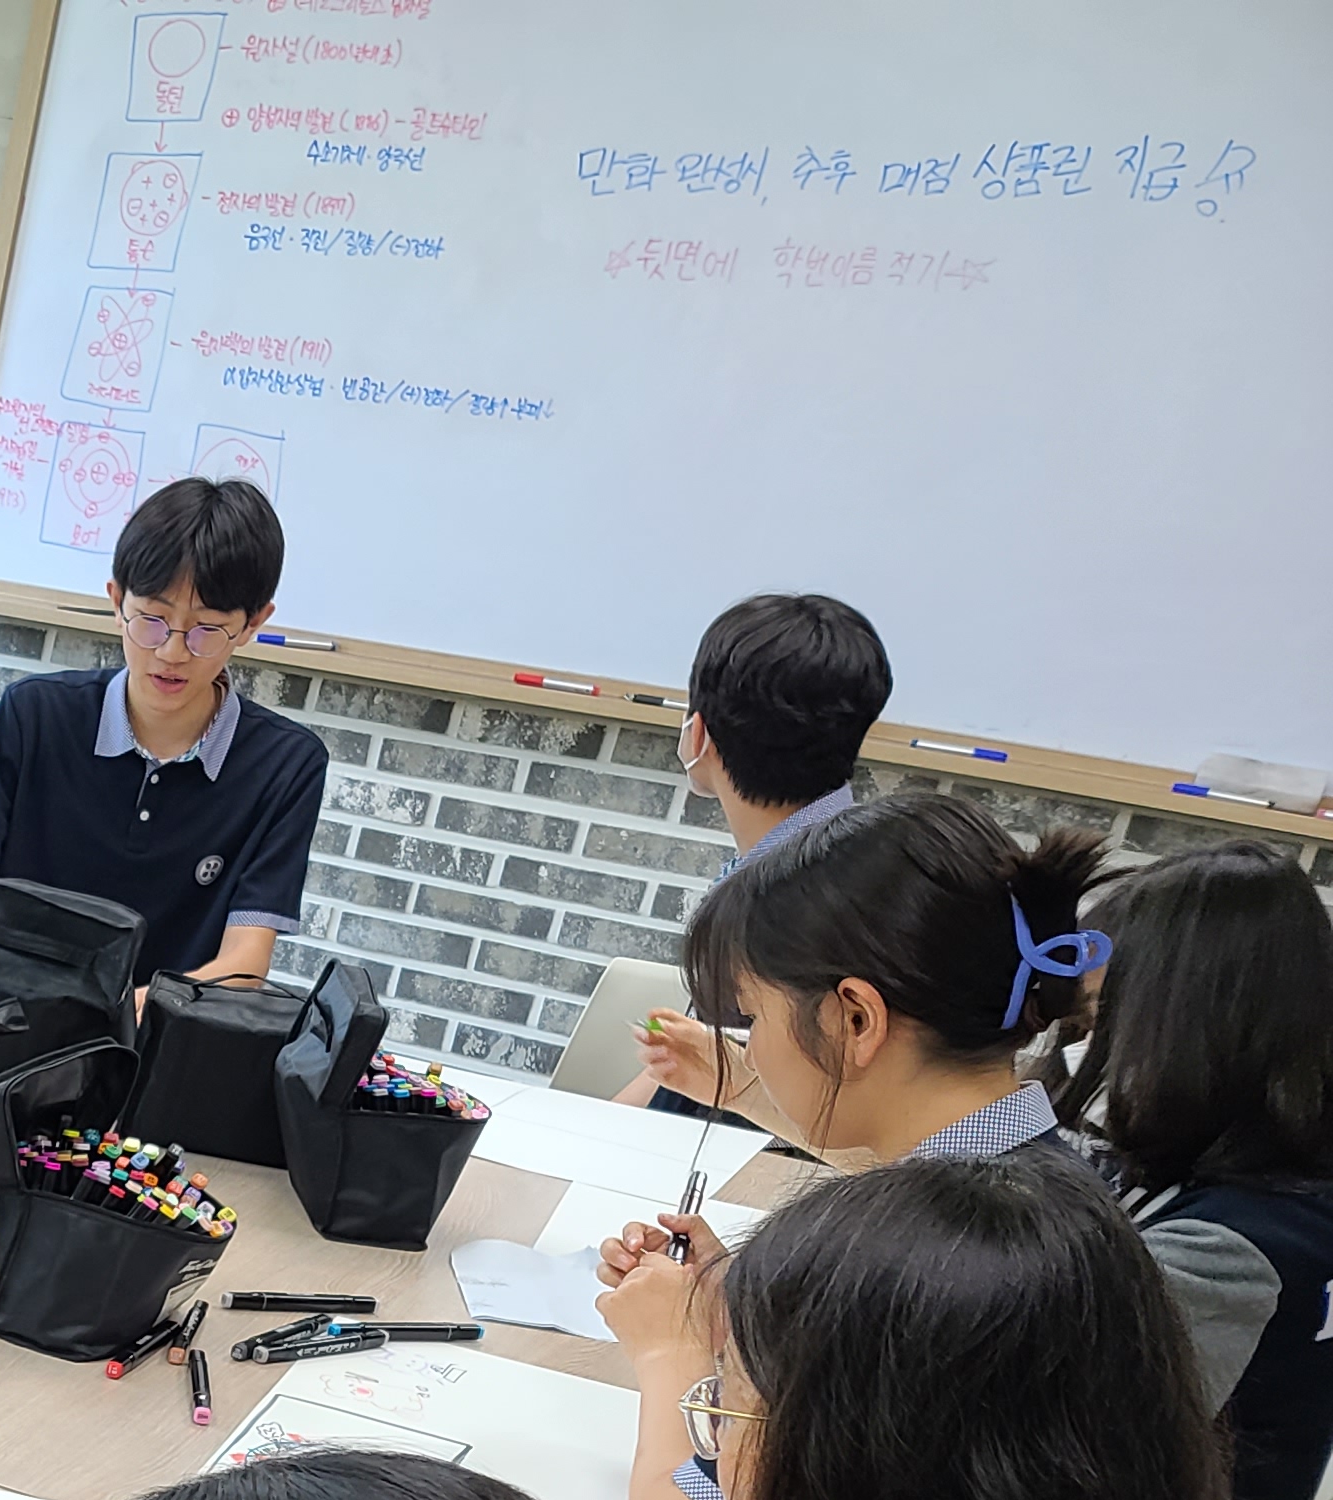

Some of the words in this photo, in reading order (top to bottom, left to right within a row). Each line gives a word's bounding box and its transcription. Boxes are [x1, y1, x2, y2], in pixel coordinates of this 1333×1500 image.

[241, 34, 300, 63] 원자설
[577, 147, 667, 199] 만화
[790, 146, 858, 193] 추후
[878, 153, 961, 196] 매점
[1115, 135, 1187, 201] 지급
[264, 193, 297, 218] 발견
[636, 239, 737, 281] 뒷면에
[886, 249, 951, 288] 적기
